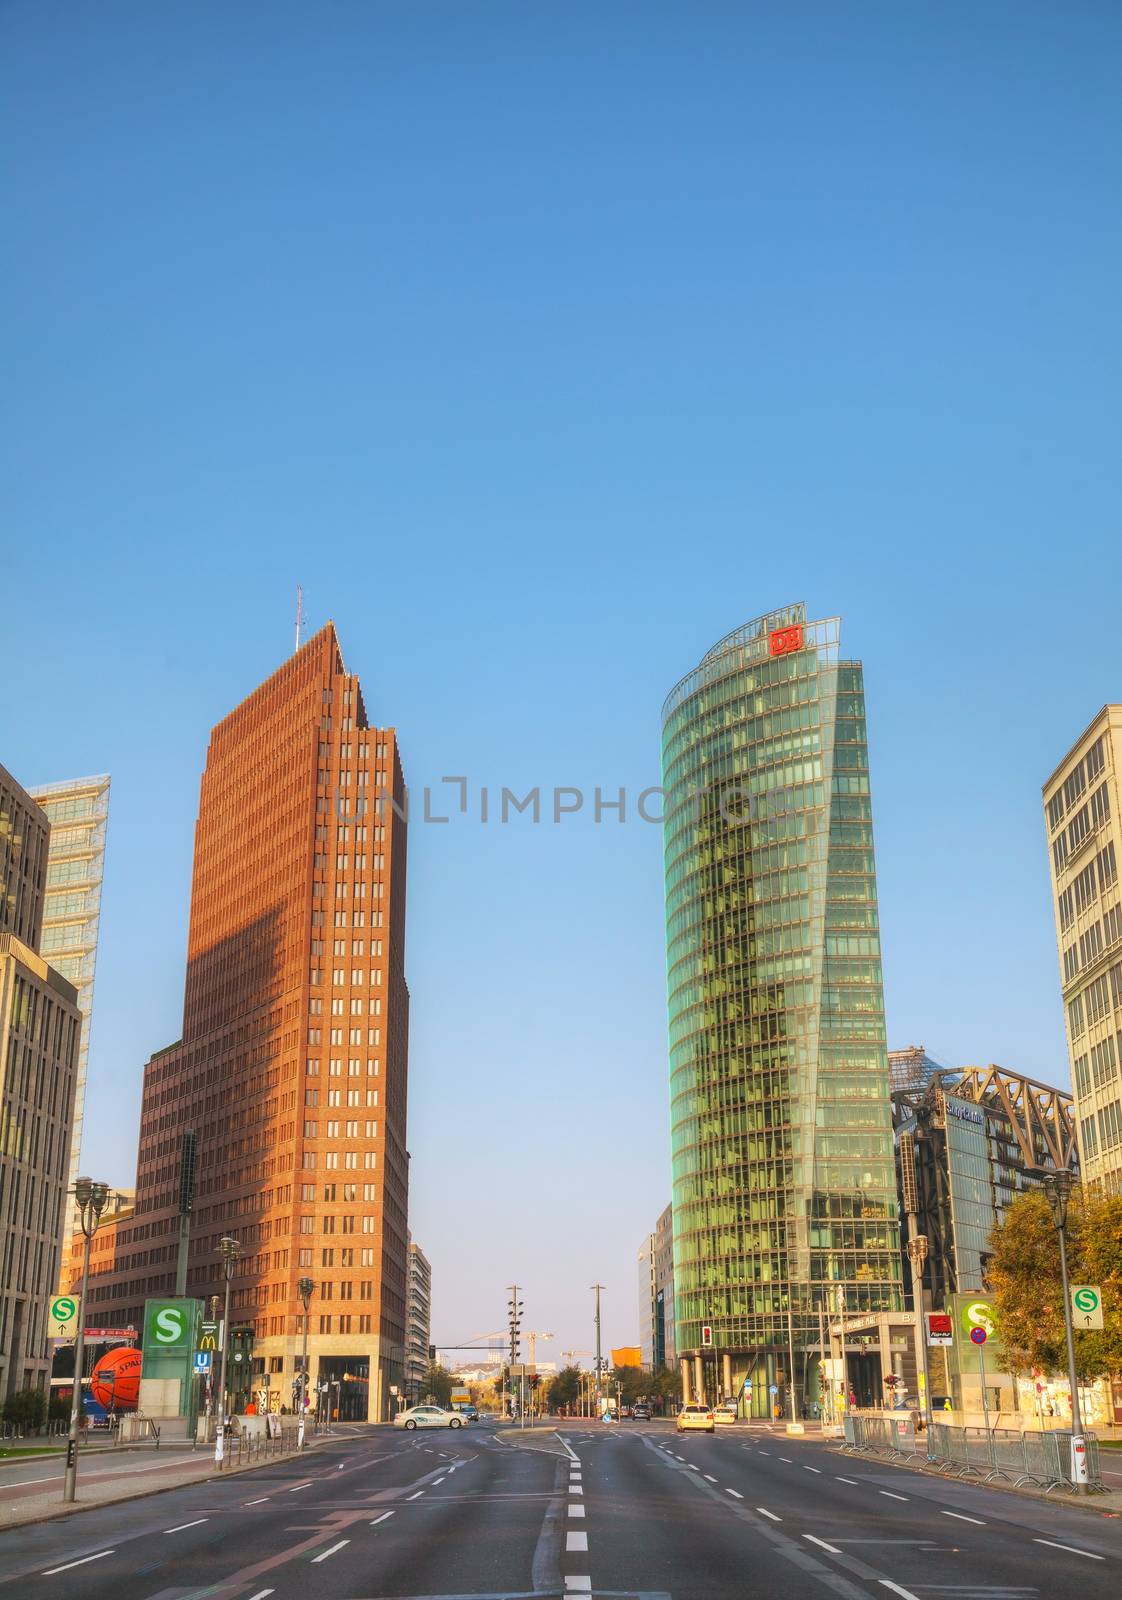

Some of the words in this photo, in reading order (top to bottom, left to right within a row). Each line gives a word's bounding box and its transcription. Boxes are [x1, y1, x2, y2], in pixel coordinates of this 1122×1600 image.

[773, 629, 798, 651] DB
[55, 1299, 72, 1320] S
[1079, 1291, 1095, 1310] S
[155, 1308, 182, 1343] S
[967, 1303, 995, 1336] S
[197, 1353, 207, 1367] U
